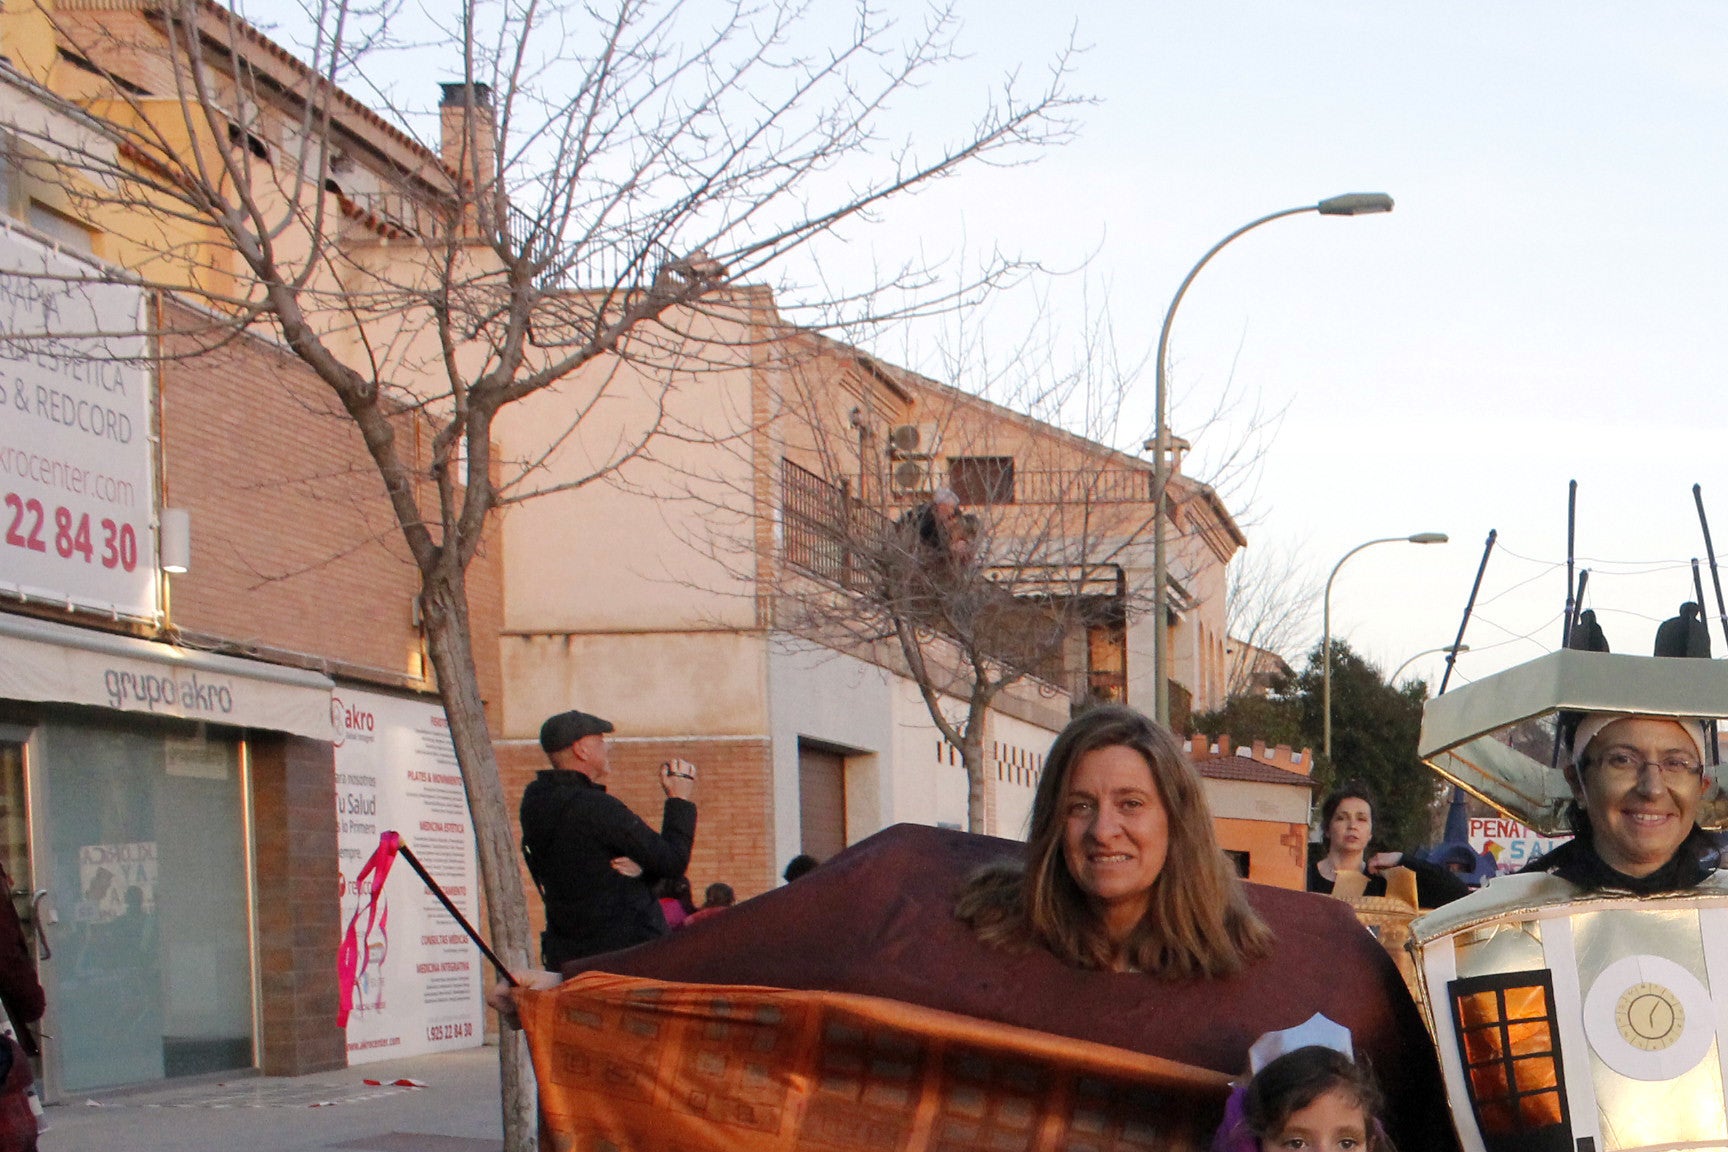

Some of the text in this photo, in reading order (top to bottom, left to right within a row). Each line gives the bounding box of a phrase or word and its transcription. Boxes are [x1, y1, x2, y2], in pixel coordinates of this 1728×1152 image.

[15, 378, 30, 413] &
[36, 385, 132, 444] REDCORD
[5, 492, 137, 572] 22 84 30
[104, 669, 232, 713] grupo akro
[345, 703, 374, 732] akro
[348, 793, 376, 815] Salud
[445, 1025, 453, 1039] 22
[454, 1024, 463, 1038] 84
